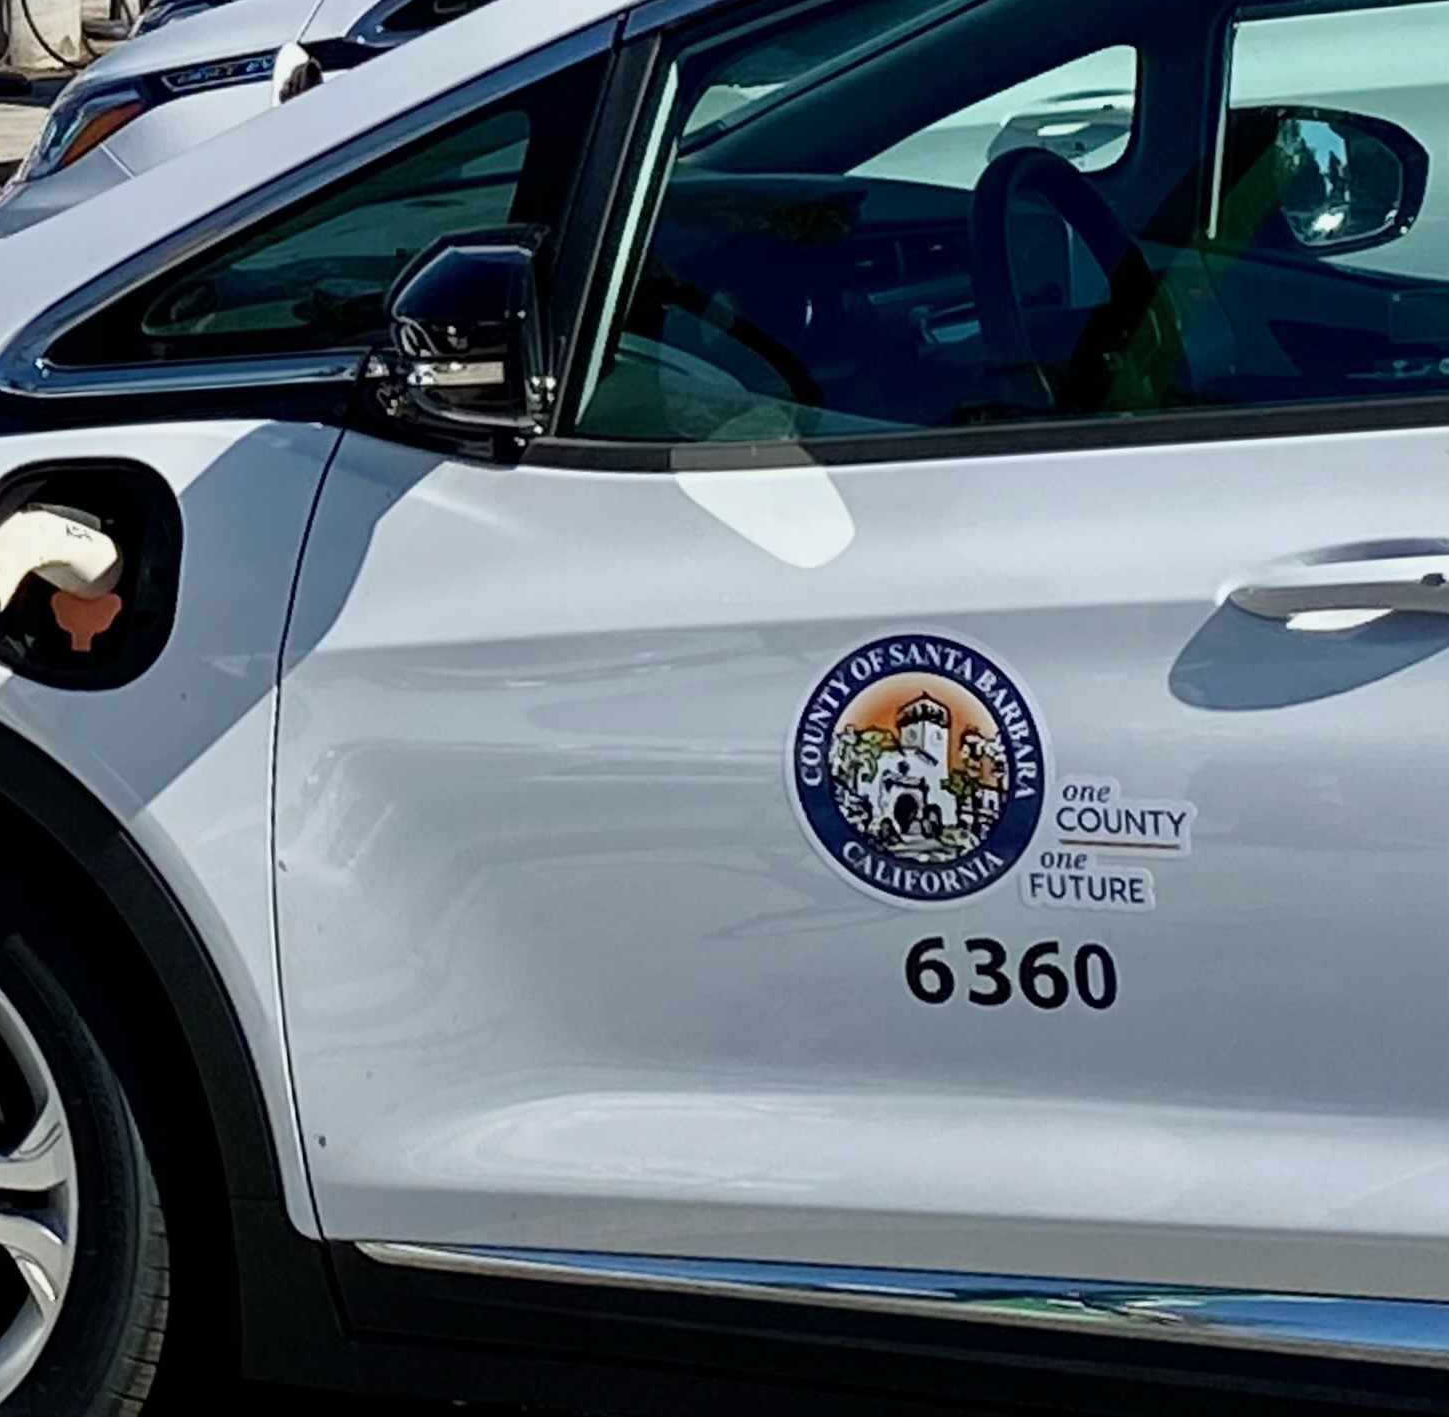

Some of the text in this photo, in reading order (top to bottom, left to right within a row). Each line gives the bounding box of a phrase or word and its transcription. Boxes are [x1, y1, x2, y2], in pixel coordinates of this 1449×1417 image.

[799, 641, 1038, 800] COUNTY OF SANTA BARBARA
[1062, 785, 1111, 804] one
[1055, 806, 1188, 838] COUNTY
[841, 839, 1006, 895] CALIFORNIA
[1039, 851, 1088, 871] one
[1029, 873, 1147, 904] FUTURE
[905, 935, 1119, 1011] 6360
